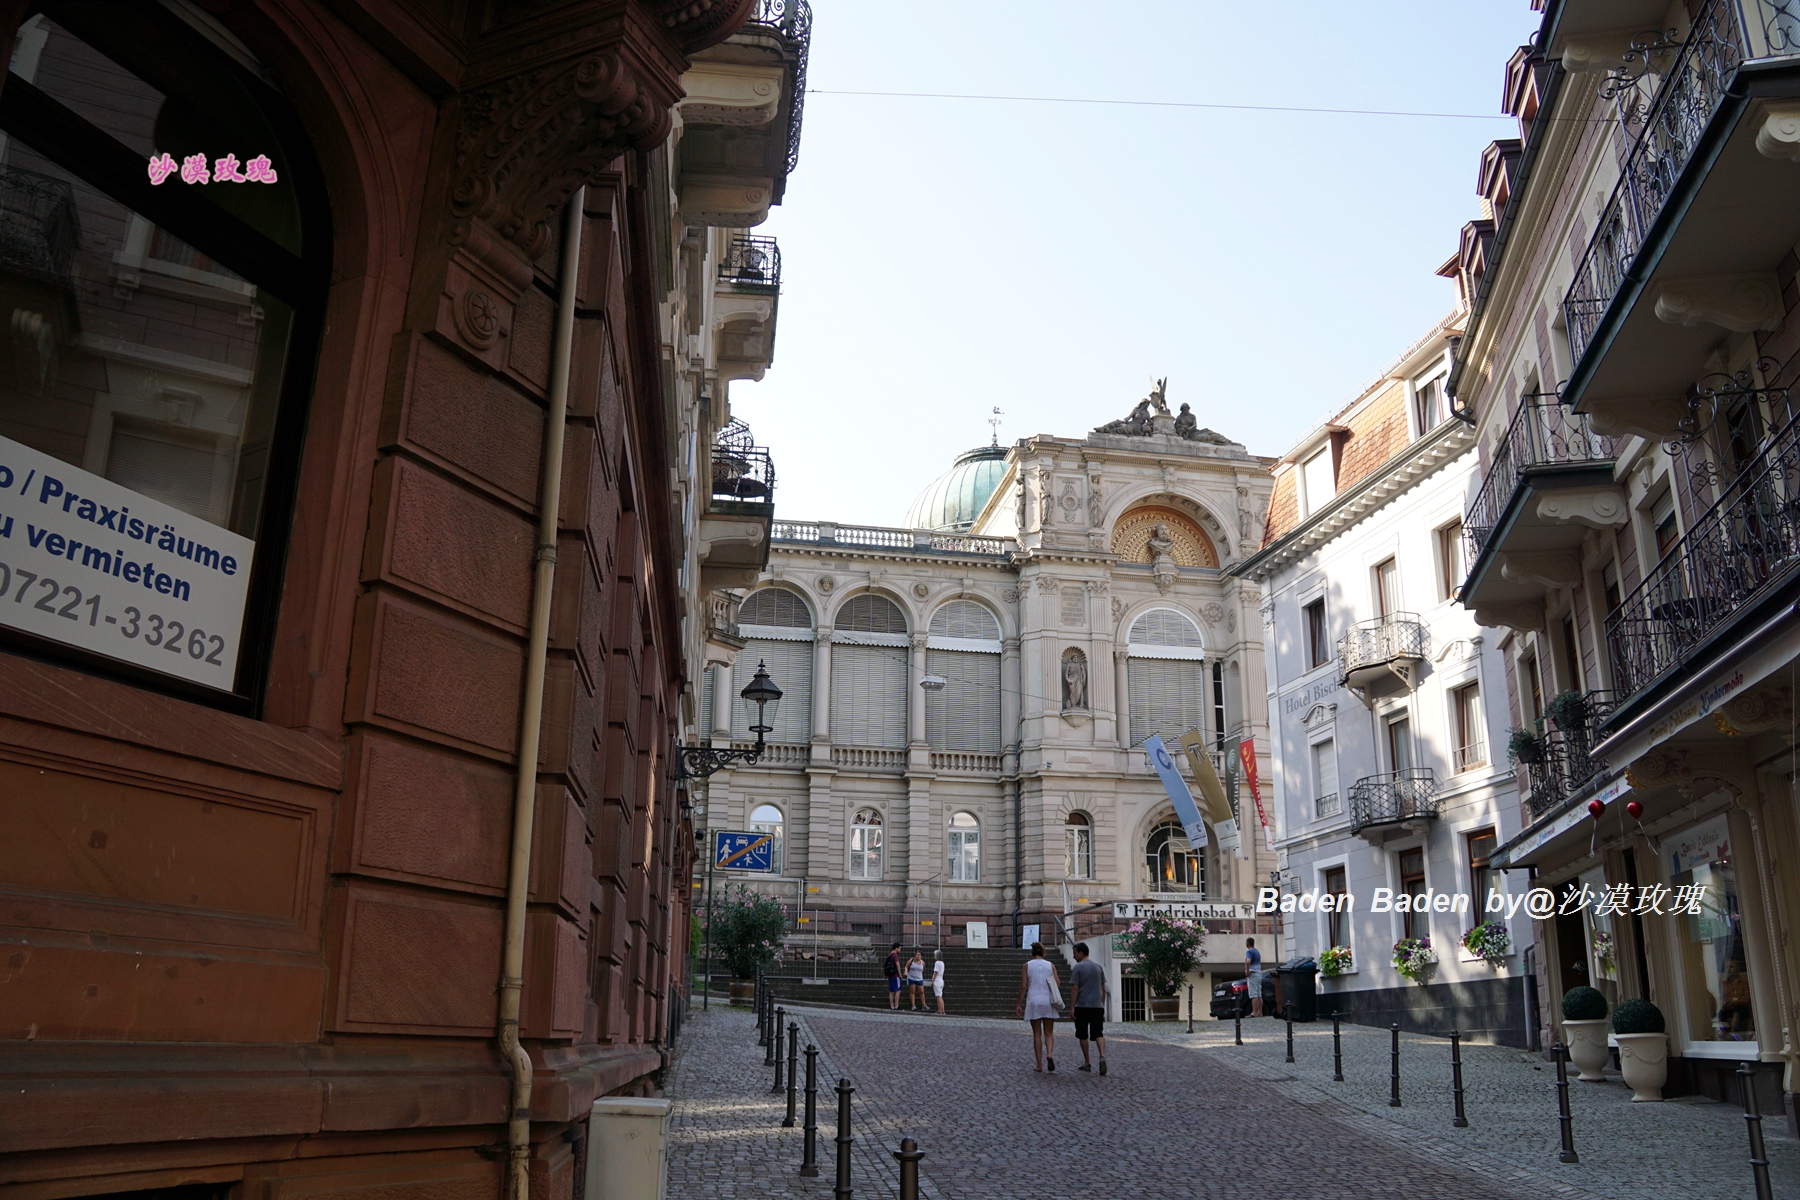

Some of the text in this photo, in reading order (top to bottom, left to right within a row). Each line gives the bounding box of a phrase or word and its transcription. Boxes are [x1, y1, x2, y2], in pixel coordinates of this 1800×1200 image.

[39, 474, 238, 576] Praxisräume
[26, 523, 191, 602] vermieten
[1285, 689, 1311, 714] Hotel
[1133, 903, 1237, 919] Friedrichsbad
